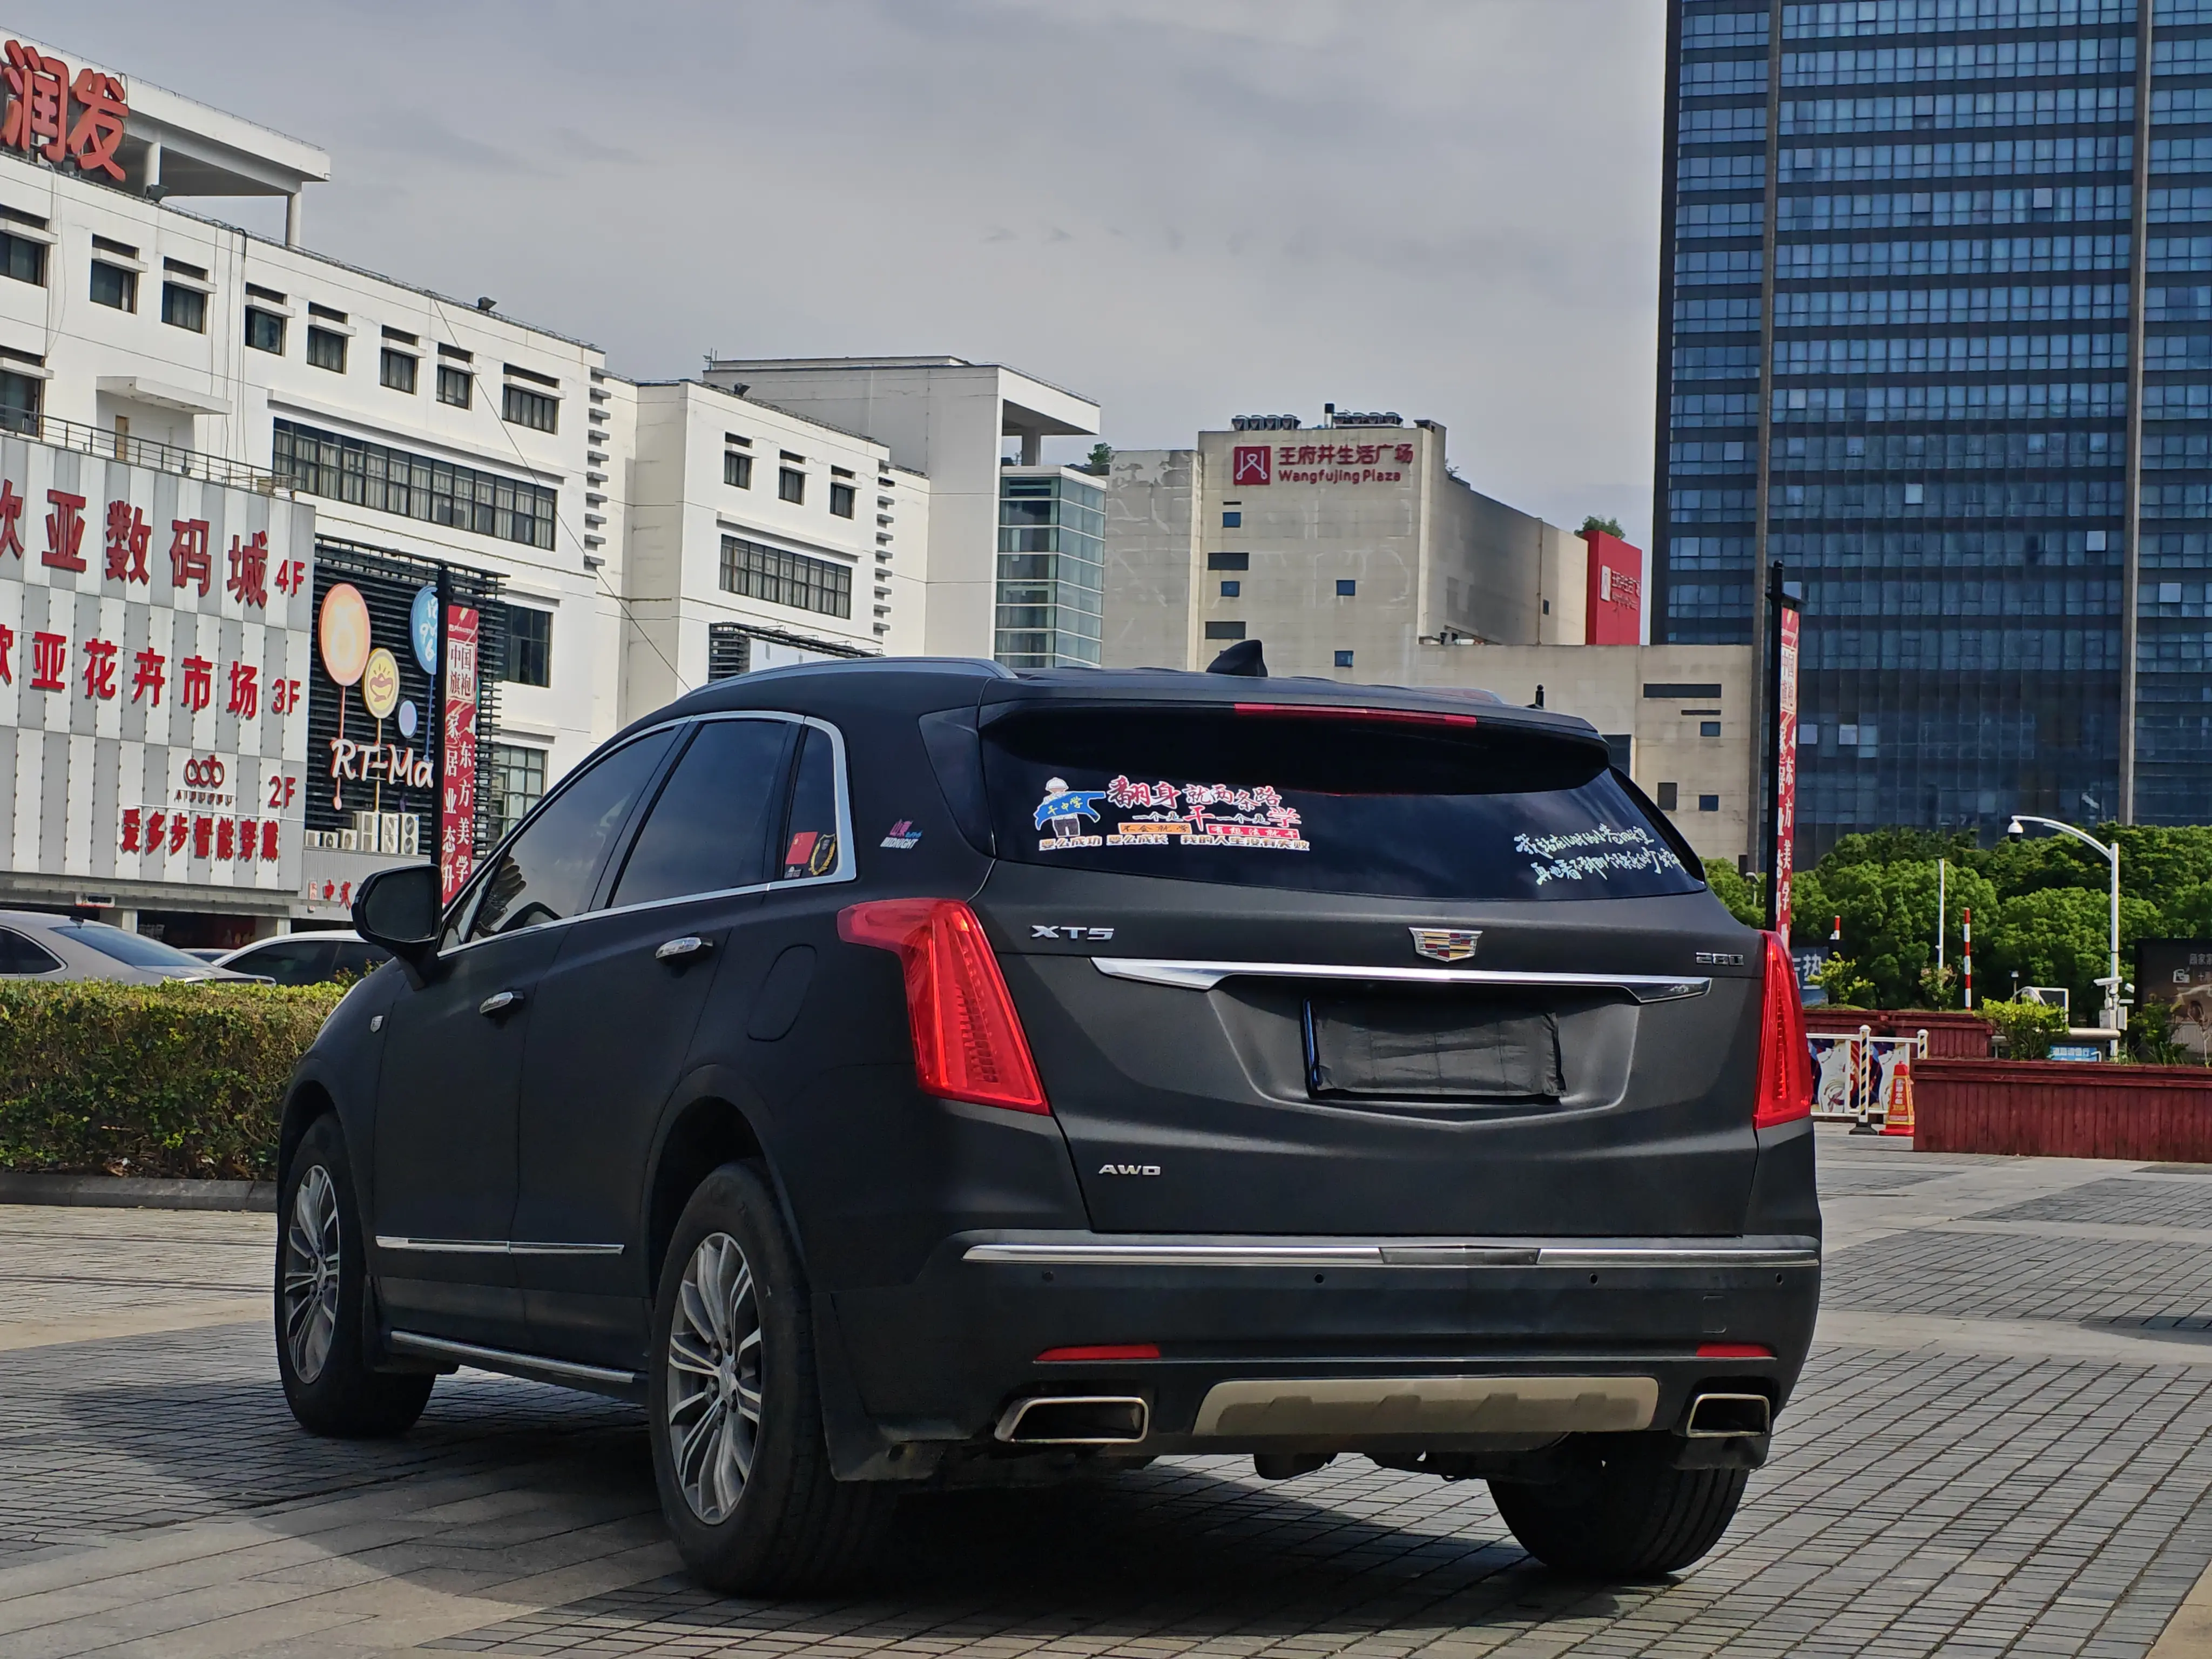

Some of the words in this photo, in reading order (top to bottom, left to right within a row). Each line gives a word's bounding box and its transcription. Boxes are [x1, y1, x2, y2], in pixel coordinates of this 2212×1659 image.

[0, 39, 130, 181] 润发
[1278, 444, 1414, 466] 王府井生活广场
[1278, 469, 1360, 484] Wangfujing
[1363, 469, 1401, 482] Plaza
[275, 559, 306, 597] 4F
[450, 645, 471, 671] 中国
[272, 678, 301, 714] 3F
[450, 671, 471, 697] 旗袍
[269, 775, 296, 808] 2F
[1107, 774, 1283, 811] 翻身就两条路
[456, 740, 473, 883] 东方美学
[1039, 836, 1103, 852] 要么成功
[1107, 834, 1169, 846] 要么成长
[1181, 834, 1310, 851] 我的人生没有失败
[1030, 925, 1115, 940] XT5
[1097, 1164, 1162, 1176] AWD
